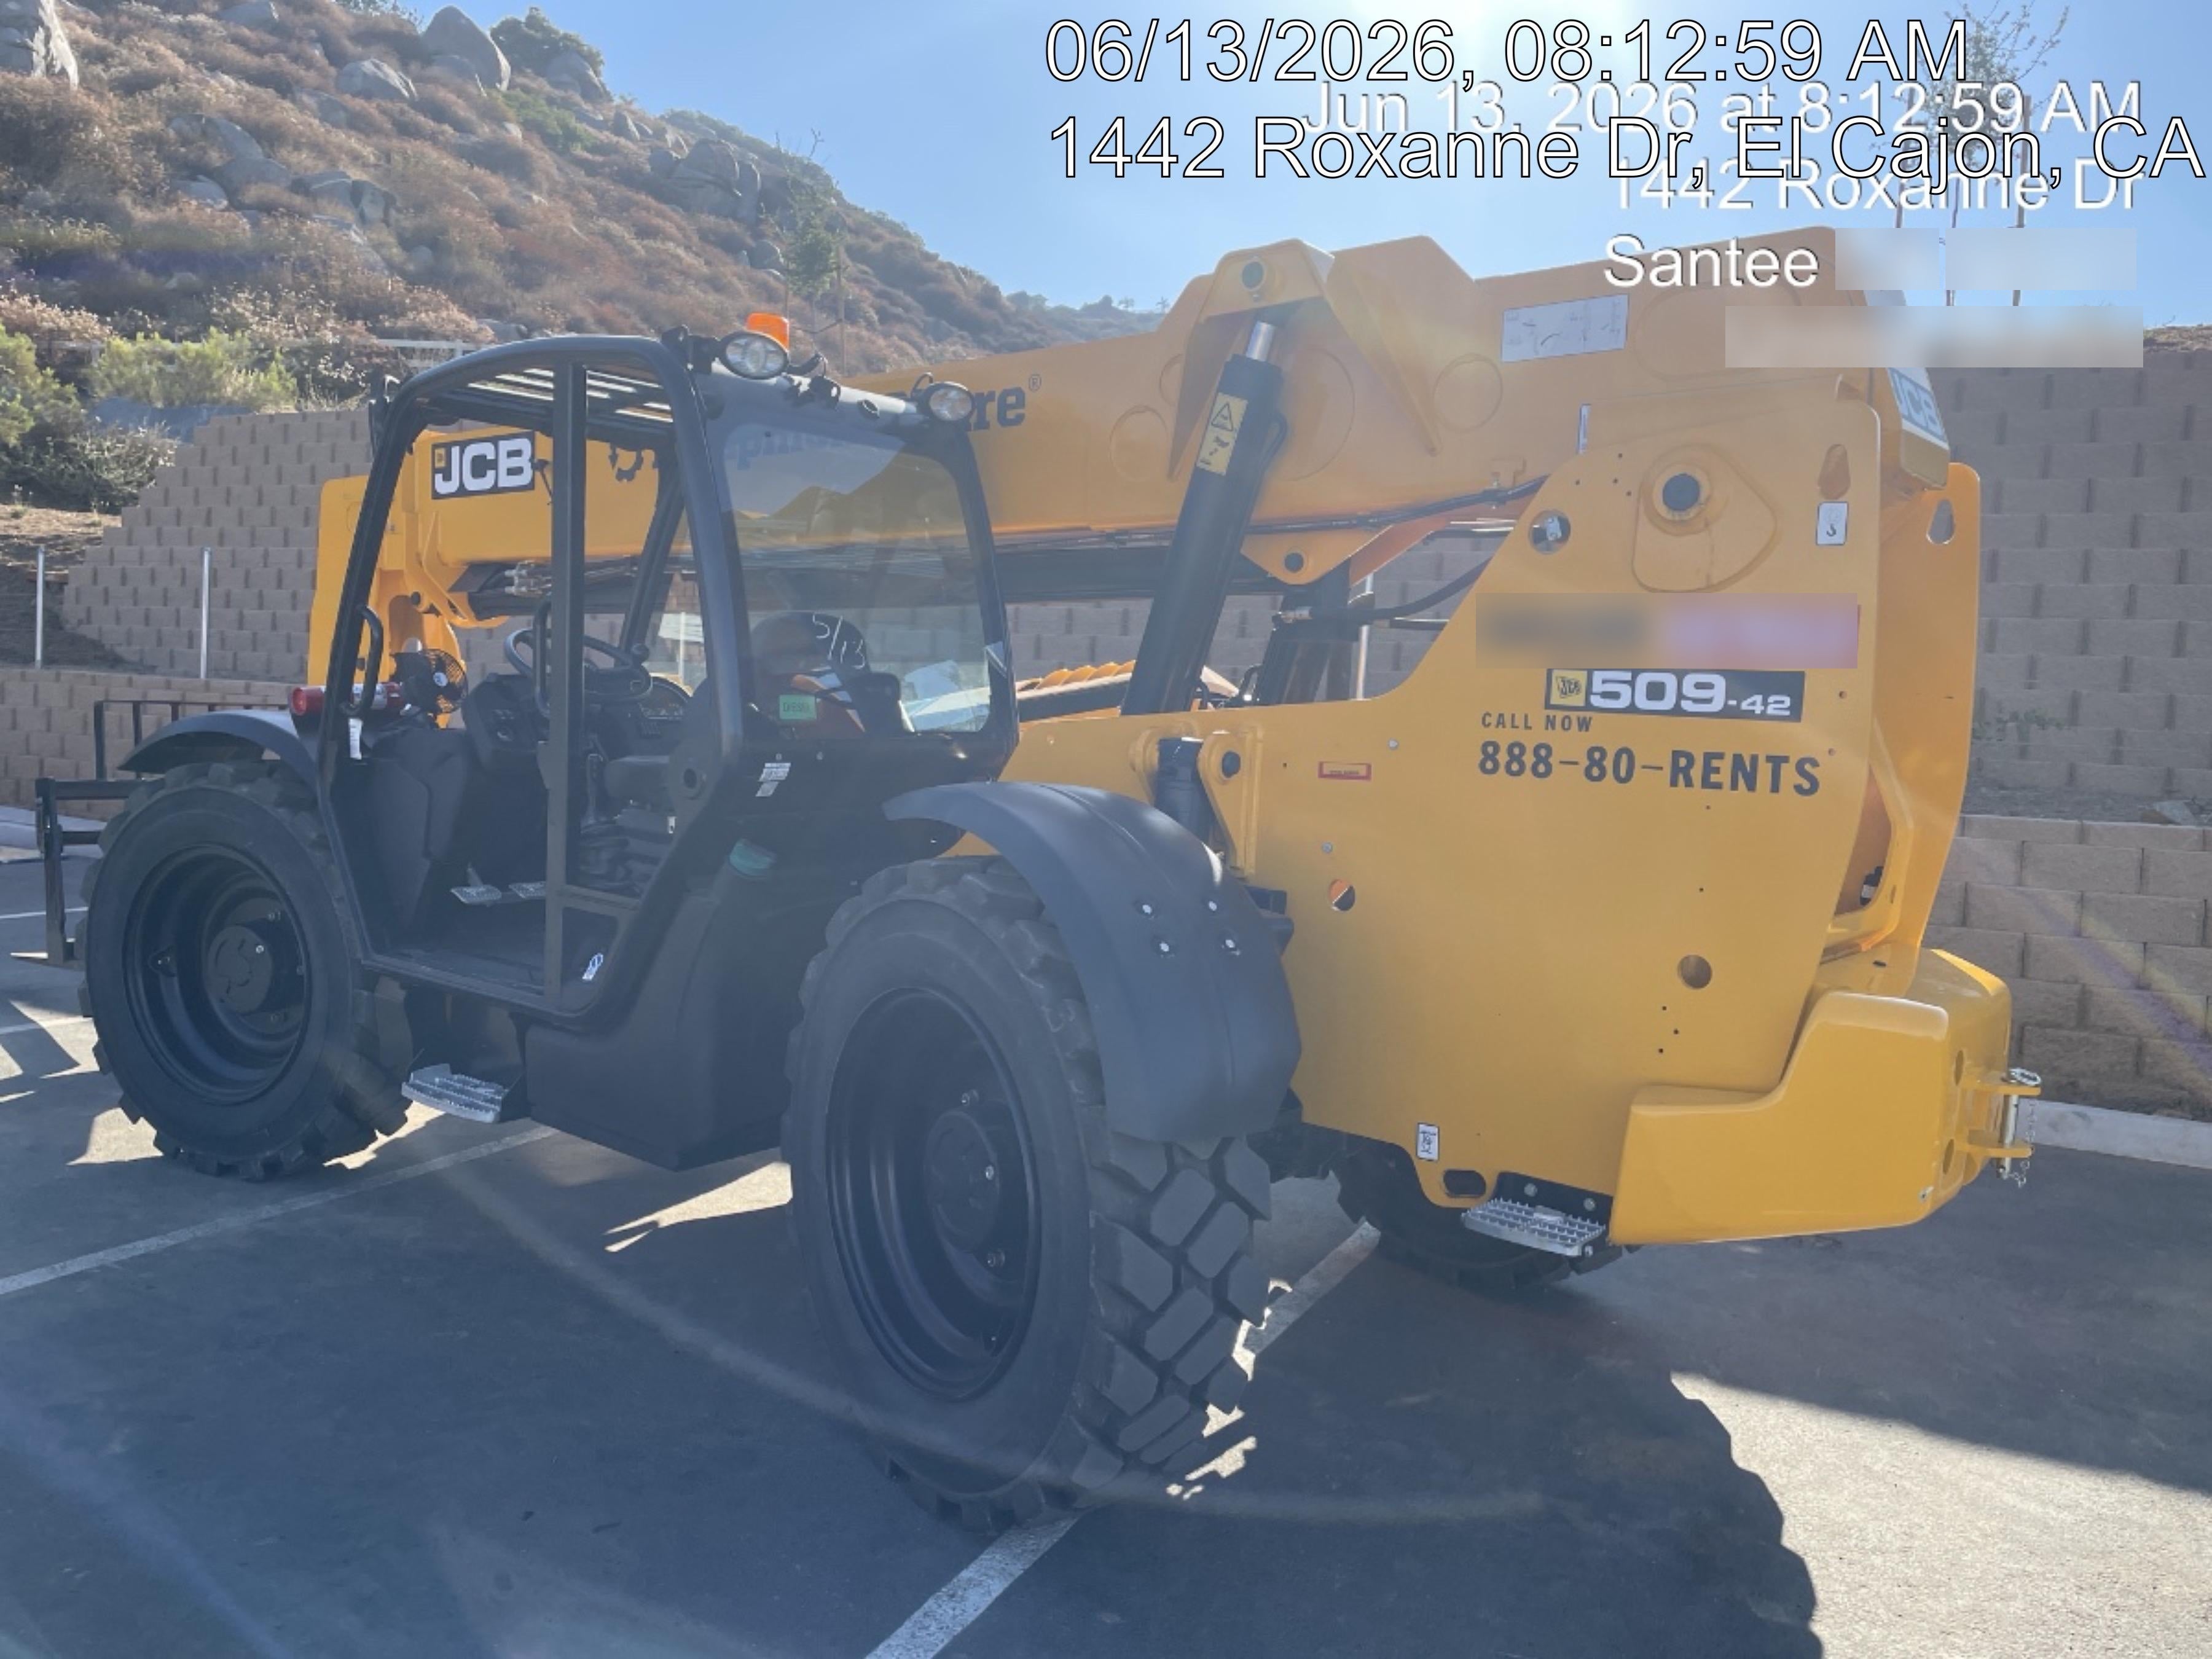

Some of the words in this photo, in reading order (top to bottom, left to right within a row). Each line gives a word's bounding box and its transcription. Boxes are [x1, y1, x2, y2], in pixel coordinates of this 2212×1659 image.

[434, 437, 533, 495] JCB
[812, 613, 866, 670] 5/13
[1590, 670, 1791, 717] 509-42
[1481, 712, 1533, 731] CALL
[1543, 714, 1593, 733] NOW
[1477, 740, 1821, 797] 888-80-RENTS
